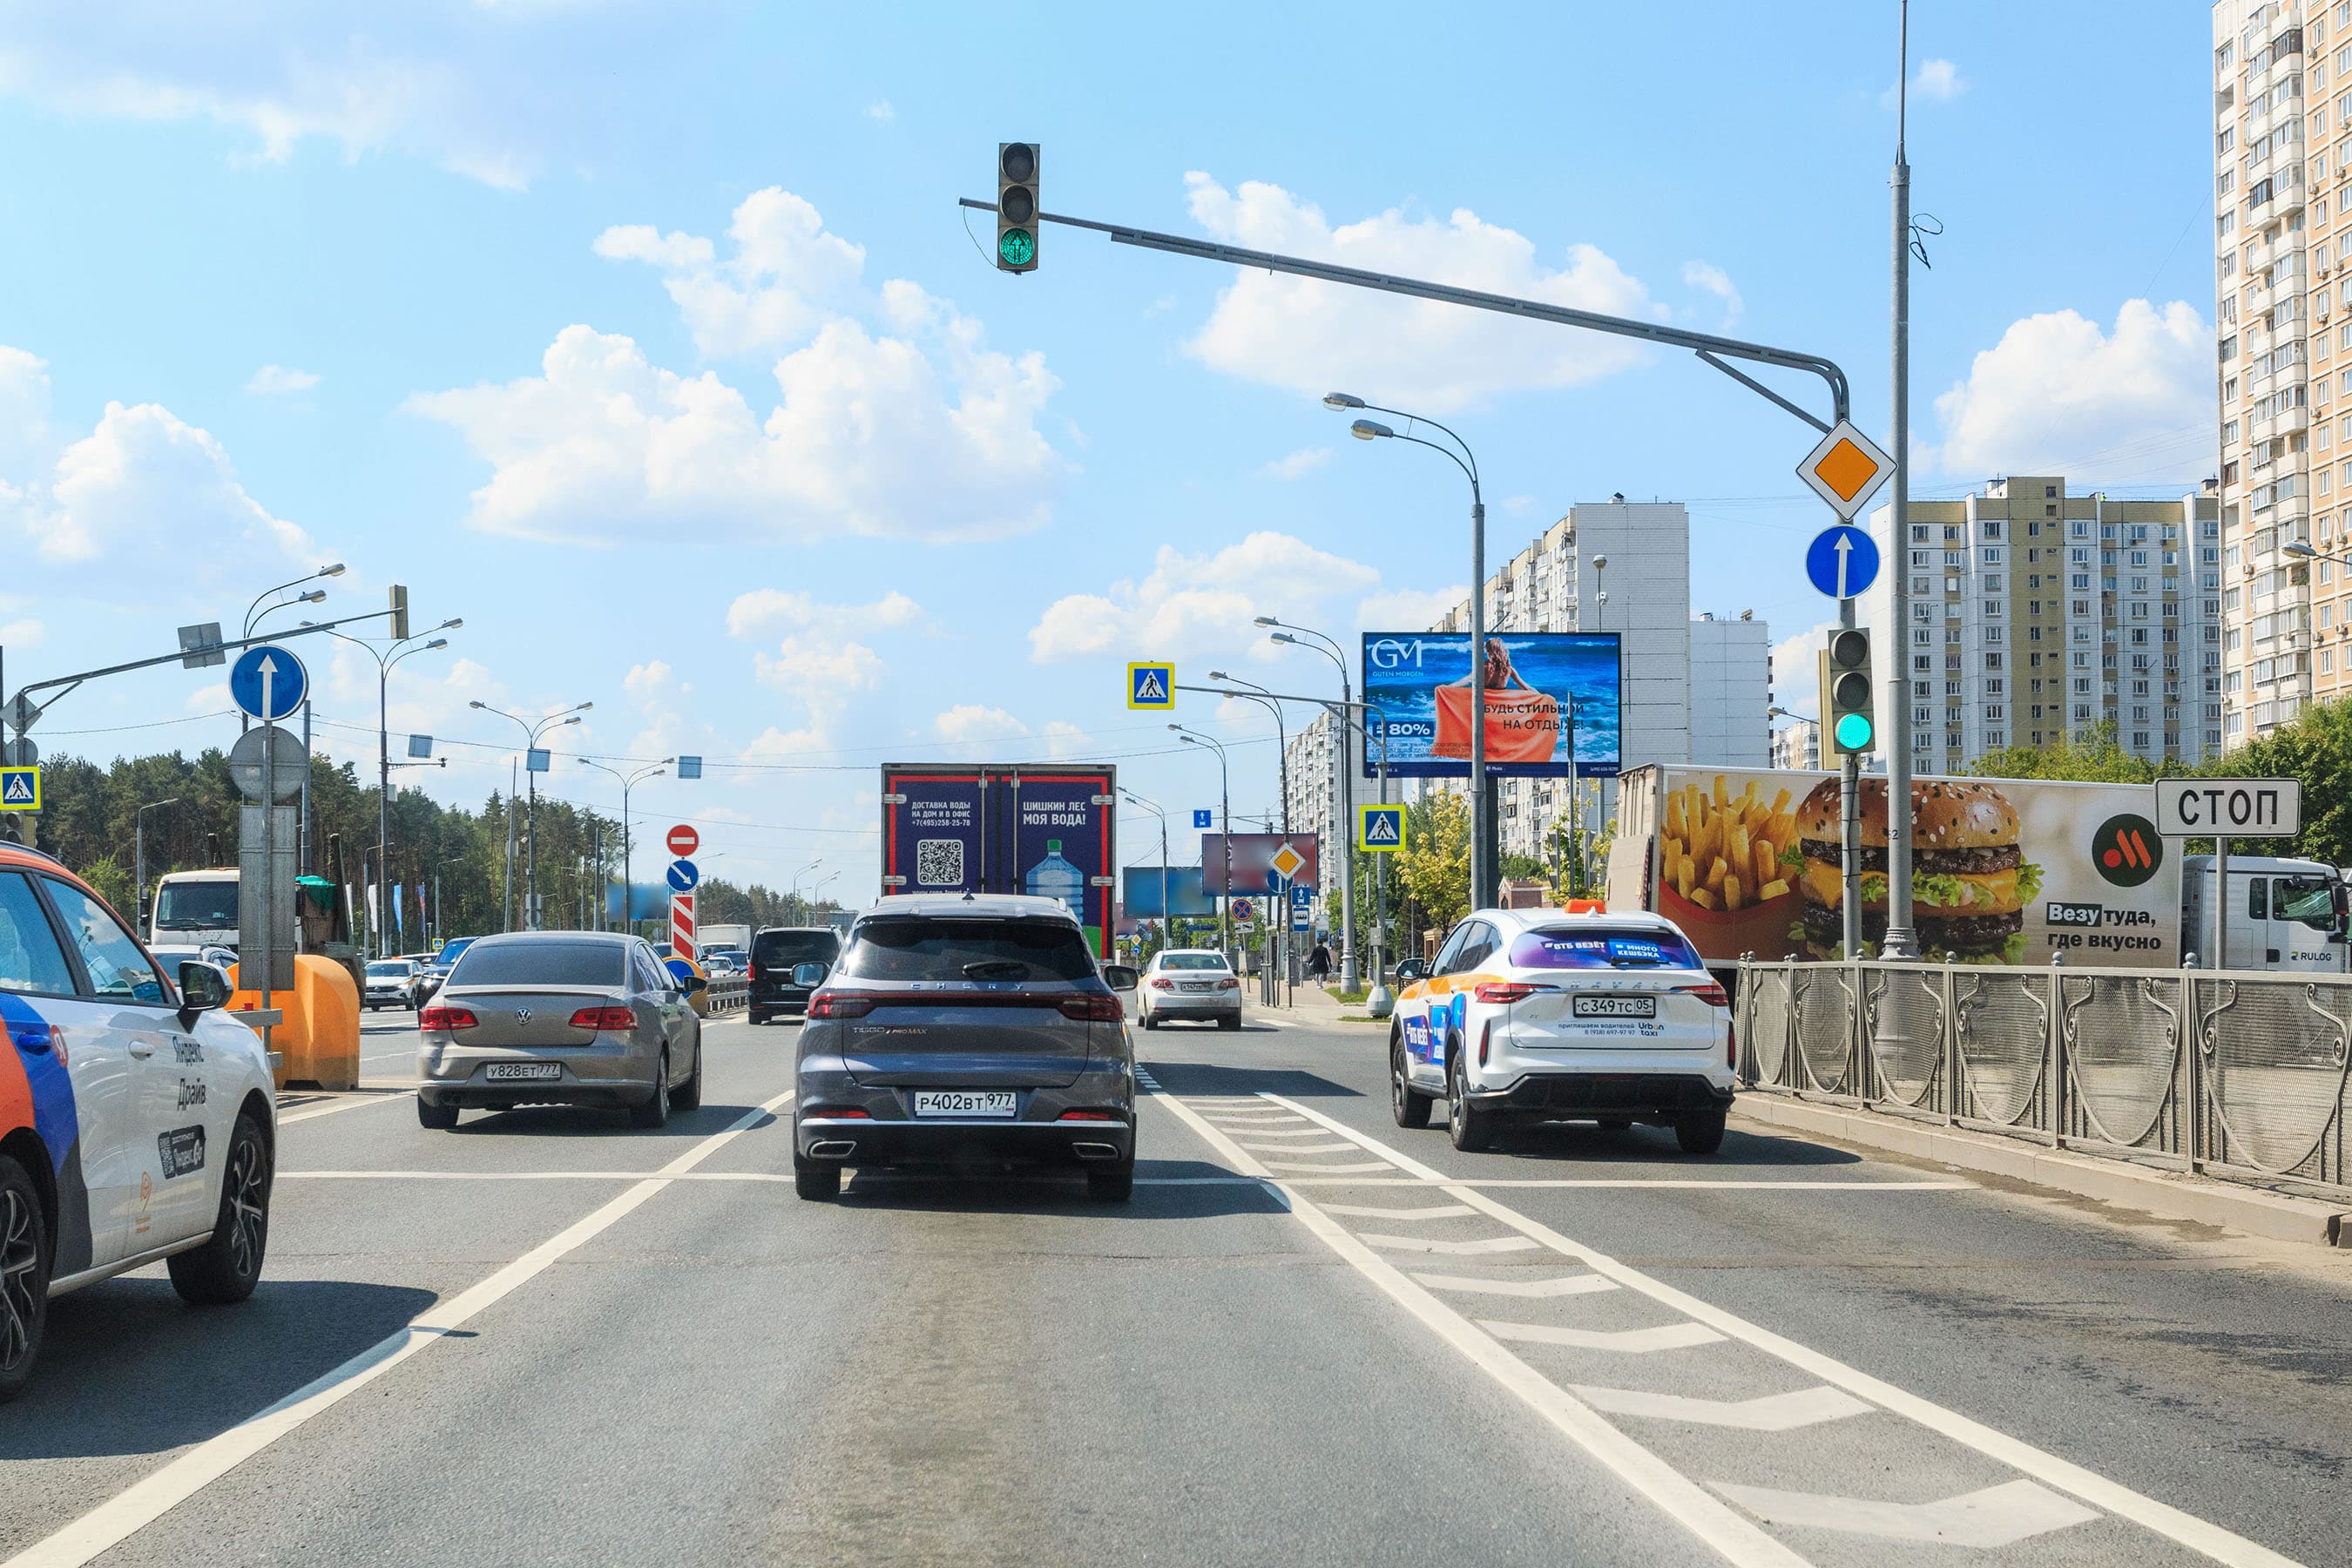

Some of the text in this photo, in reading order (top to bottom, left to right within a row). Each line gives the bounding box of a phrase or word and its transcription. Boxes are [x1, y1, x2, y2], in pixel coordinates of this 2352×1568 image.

[1484, 704, 1514, 714] БУДЬ
[1389, 724, 1430, 735] 80%
[1504, 720, 1521, 730] НА
[911, 801, 970, 810] ДОСТАВКА ВОДЫ
[1023, 801, 1086, 812] ШИШКИН ЛЕС
[2178, 789, 2278, 826] СТОП
[923, 810, 937, 819] ДОМ
[1023, 814, 1086, 827] МОЯ ВОДА!
[2049, 904, 2156, 927] Везу туда,
[2048, 934, 2162, 951] где вкусно
[1617, 950, 1660, 958] КЕШБЭКА
[2301, 952, 2332, 962] RULOG
[1636, 999, 1649, 1010] 05
[1638, 1022, 1665, 1031] Urban
[490, 1064, 558, 1078] У828ЕТ 777
[177, 1078, 206, 1112] Драйв
[920, 1093, 1012, 1110] Р402ВТ 977
